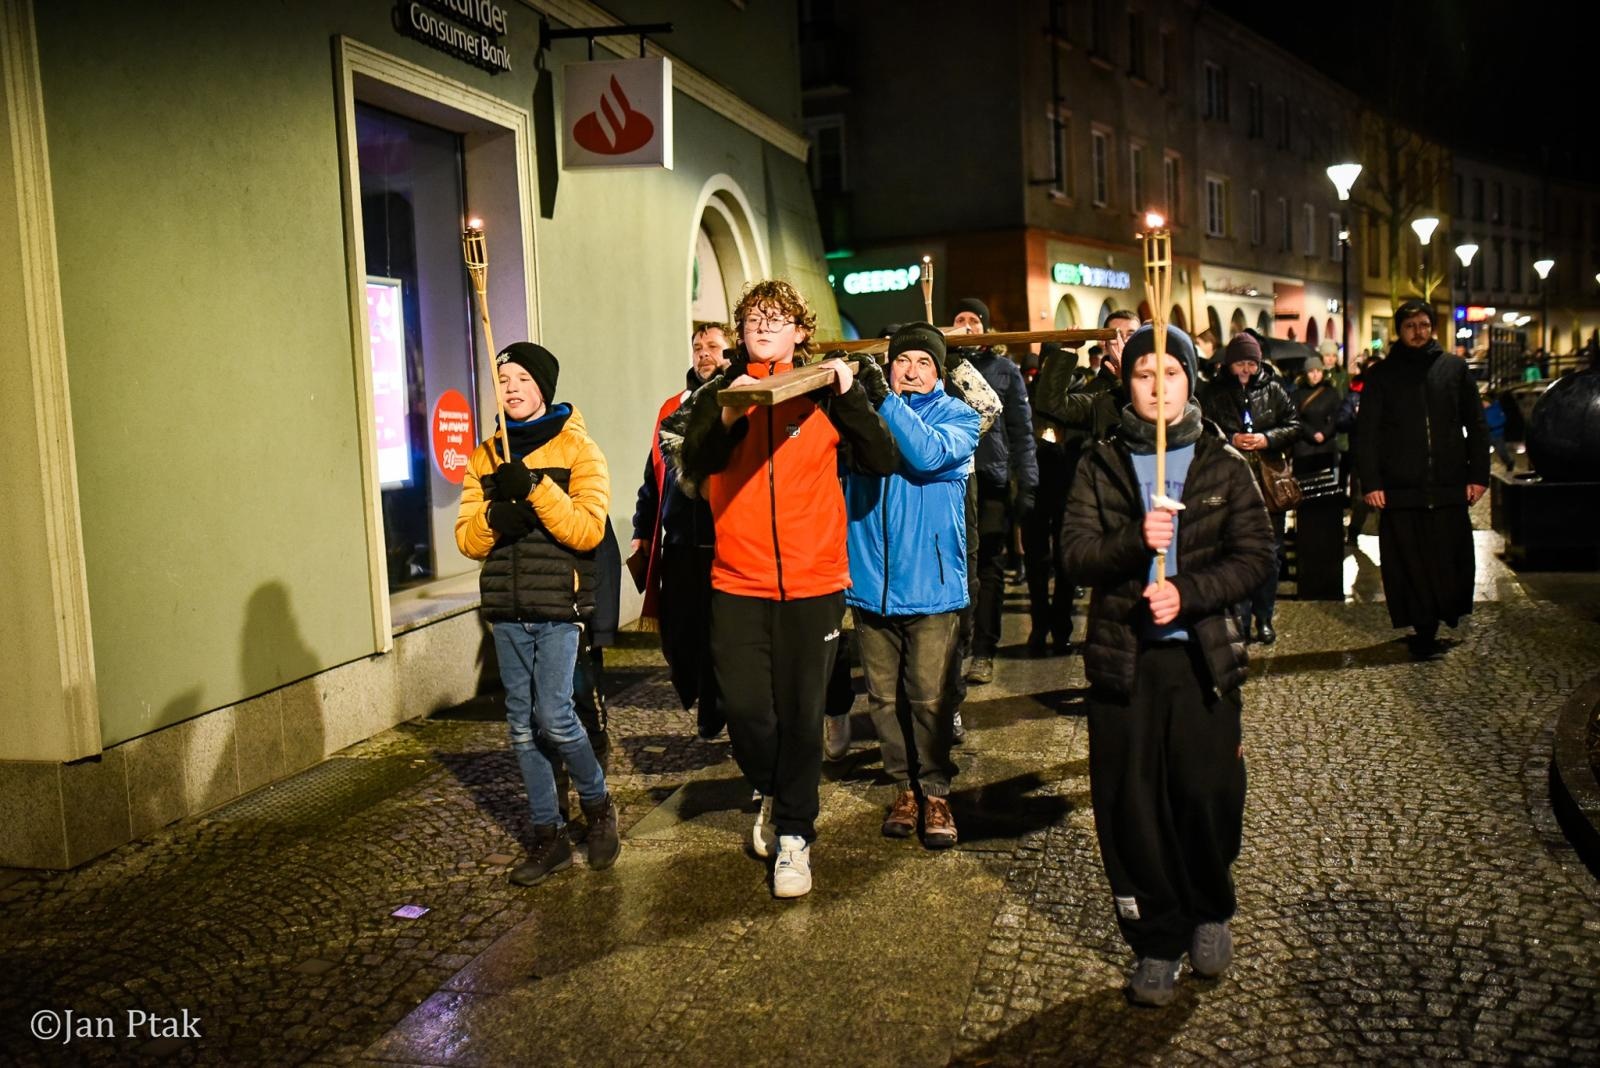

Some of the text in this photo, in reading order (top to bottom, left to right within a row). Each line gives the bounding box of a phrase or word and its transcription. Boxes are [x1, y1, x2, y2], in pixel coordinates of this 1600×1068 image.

[410, 2, 512, 71] Consumer Bank
[437, 0, 508, 35] ander
